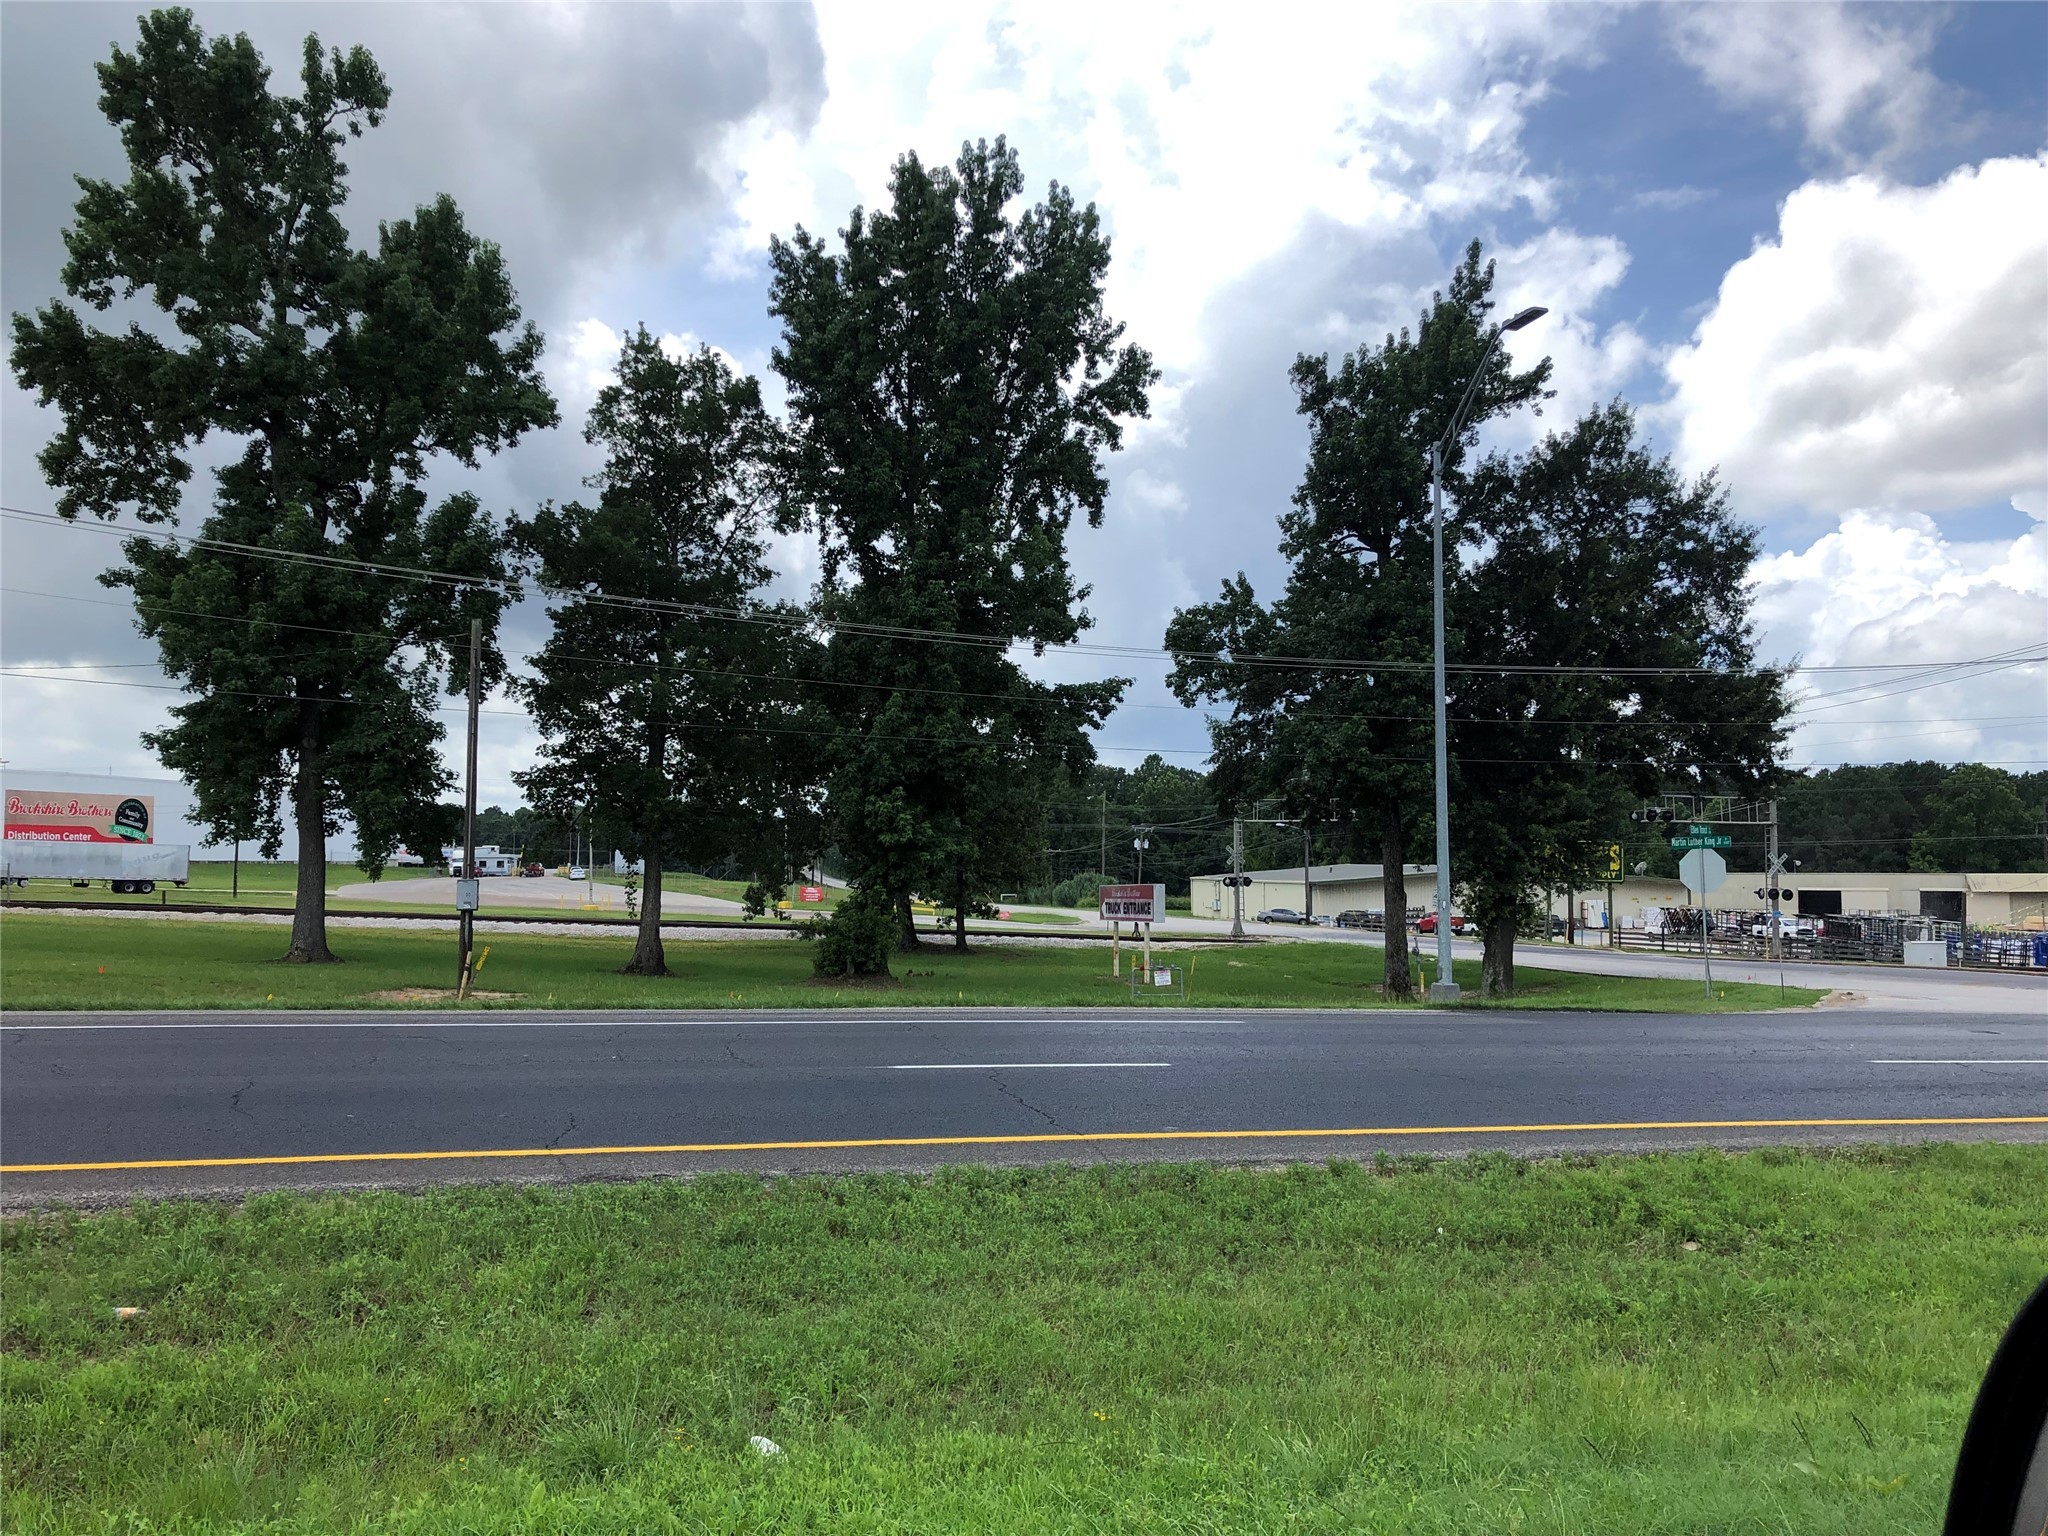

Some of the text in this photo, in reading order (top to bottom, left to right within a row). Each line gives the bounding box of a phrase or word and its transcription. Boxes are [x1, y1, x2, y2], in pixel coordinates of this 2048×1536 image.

[8, 797, 113, 817] Brookshire Brothers
[7, 831, 92, 841] Distribution Center
[113, 826, 131, 836] SINCE
[1671, 838, 1686, 846] Martin
[1688, 838, 1703, 846] Luther
[1704, 837, 1716, 847] King
[1105, 902, 1151, 915] TRUCK ENTRANCE
